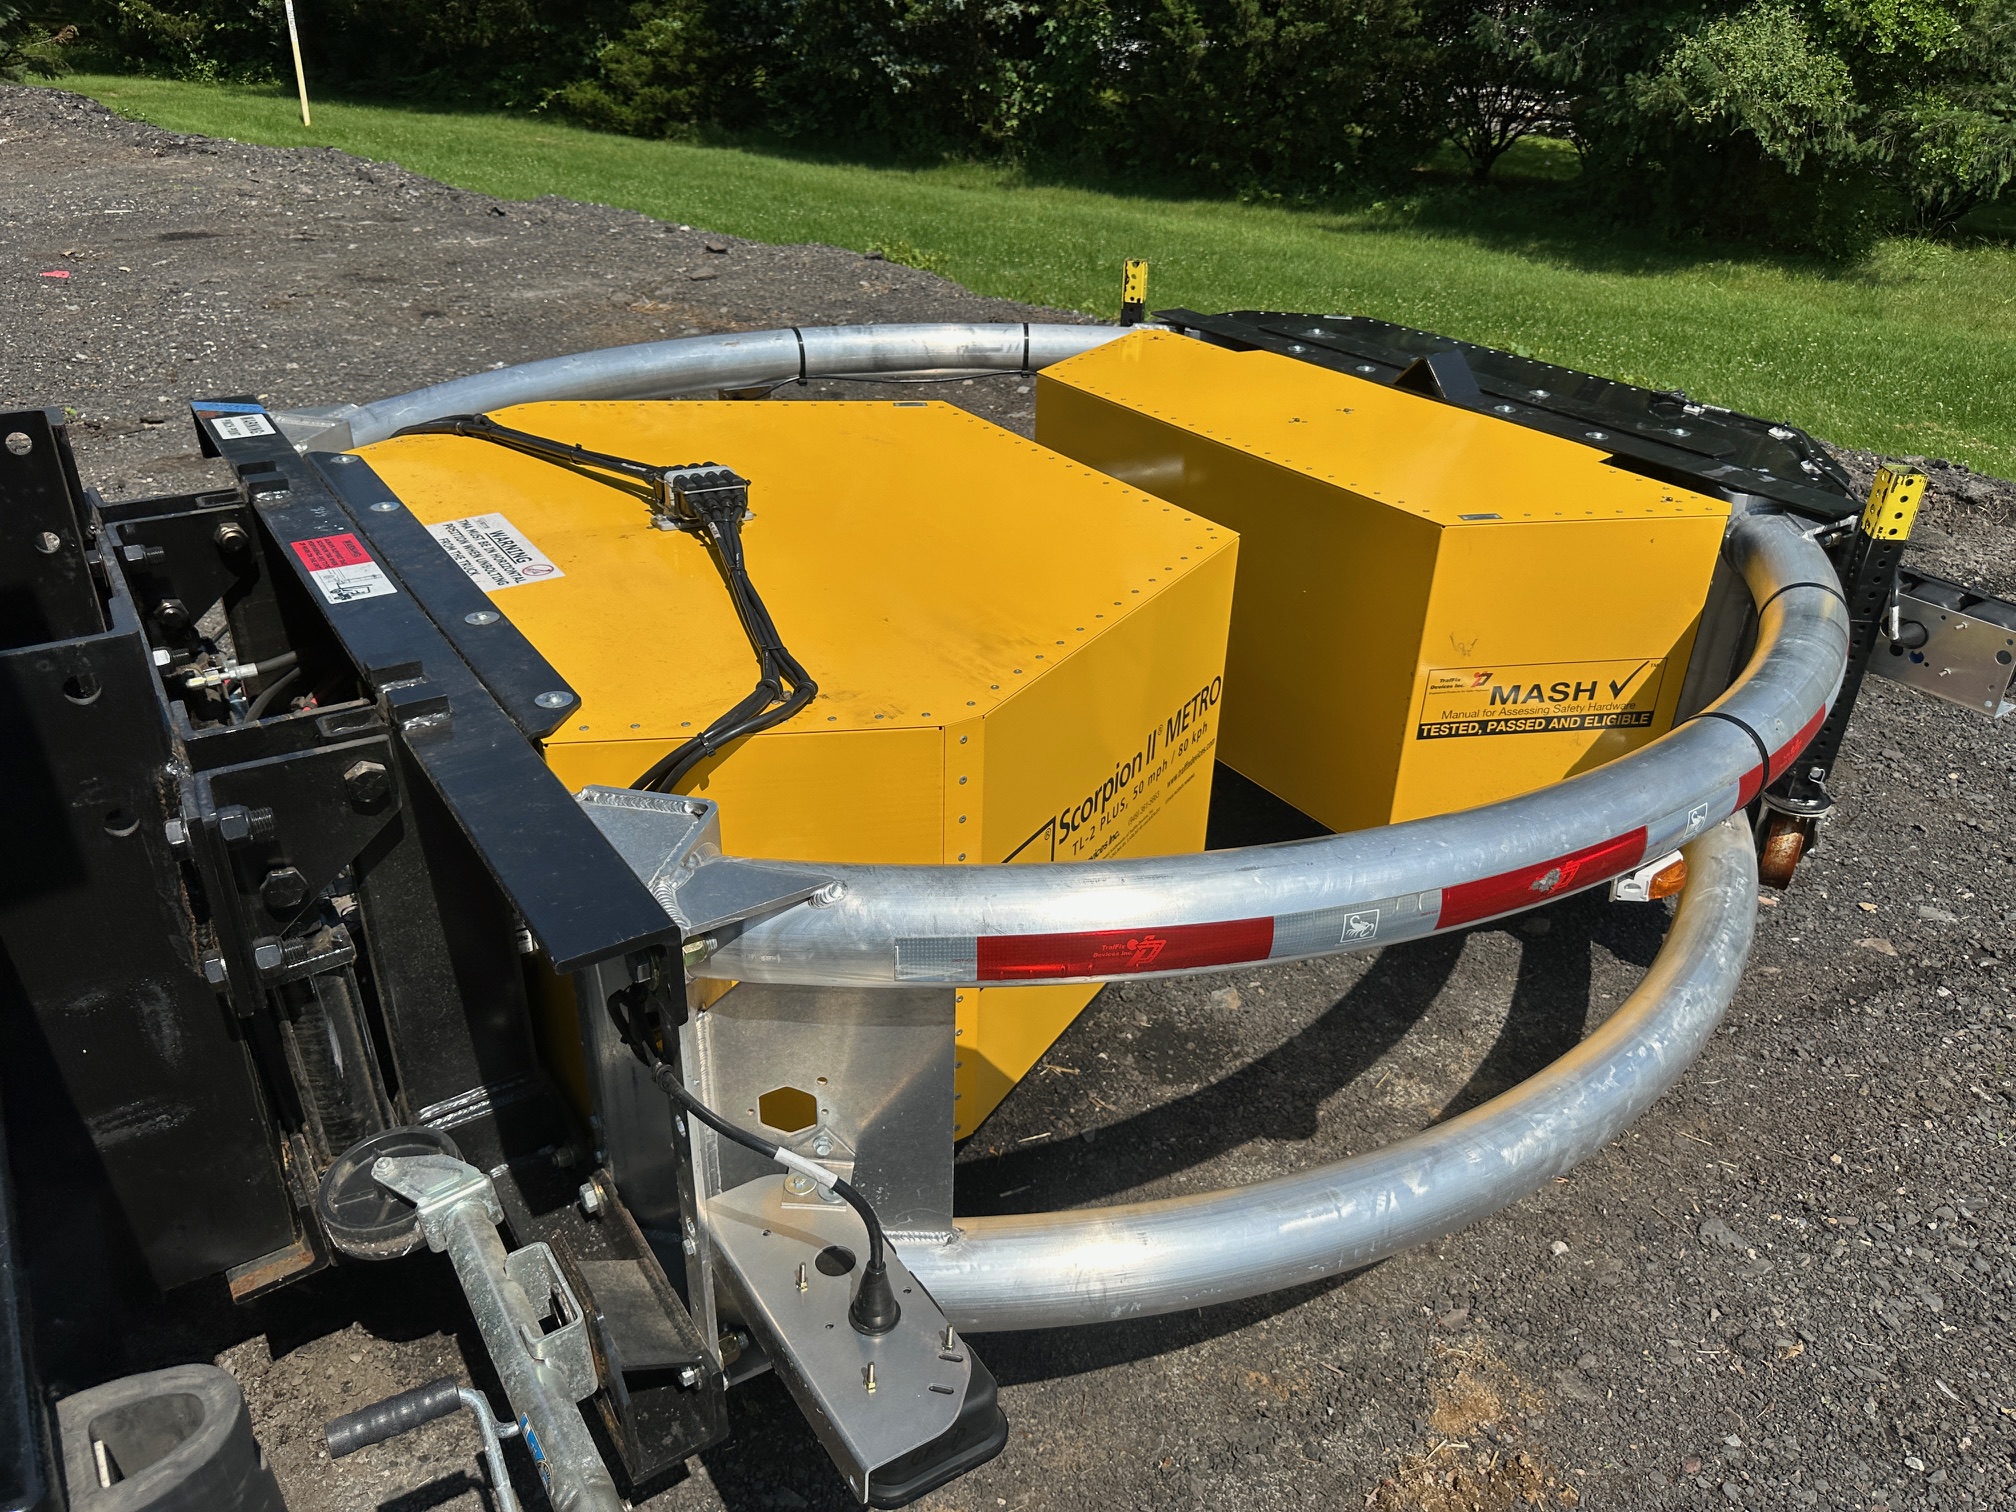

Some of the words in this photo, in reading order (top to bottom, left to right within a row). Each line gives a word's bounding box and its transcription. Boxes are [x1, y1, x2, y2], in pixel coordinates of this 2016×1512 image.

[458, 519, 472, 529] TMA
[468, 528, 485, 542] MUST
[439, 537, 458, 551] FROM
[450, 550, 466, 560] THE
[458, 559, 481, 576] TRUCK
[443, 523, 470, 544] POSITION
[463, 543, 481, 558] WHEN
[476, 557, 509, 586] UNBOLTING
[487, 546, 497, 554] IN
[489, 530, 533, 563] WARNING
[490, 552, 527, 583] HORIZONTAL
[1489, 680, 1598, 706] MASH
[1441, 709, 1480, 720] Manual
[1481, 708, 1498, 717] for
[1500, 705, 1549, 717] Assessing
[1552, 703, 1586, 715] Safety
[1588, 701, 1636, 712] Hardware
[1421, 723, 1483, 737] TESTED,
[1487, 719, 1545, 733] PASSED
[1547, 716, 1581, 729] AND
[1585, 713, 1650, 727] ELIGIBLE
[1059, 751, 1142, 845] Scorpion
[1164, 675, 1222, 748] METRO
[1072, 826, 1096, 856] TL-2
[1099, 797, 1129, 832] PLUS,
[1133, 780, 1144, 801] 50
[1148, 759, 1167, 787] mph
[1171, 749, 1176, 764] /
[1178, 738, 1189, 757] 80
[1191, 721, 1208, 745] kph
